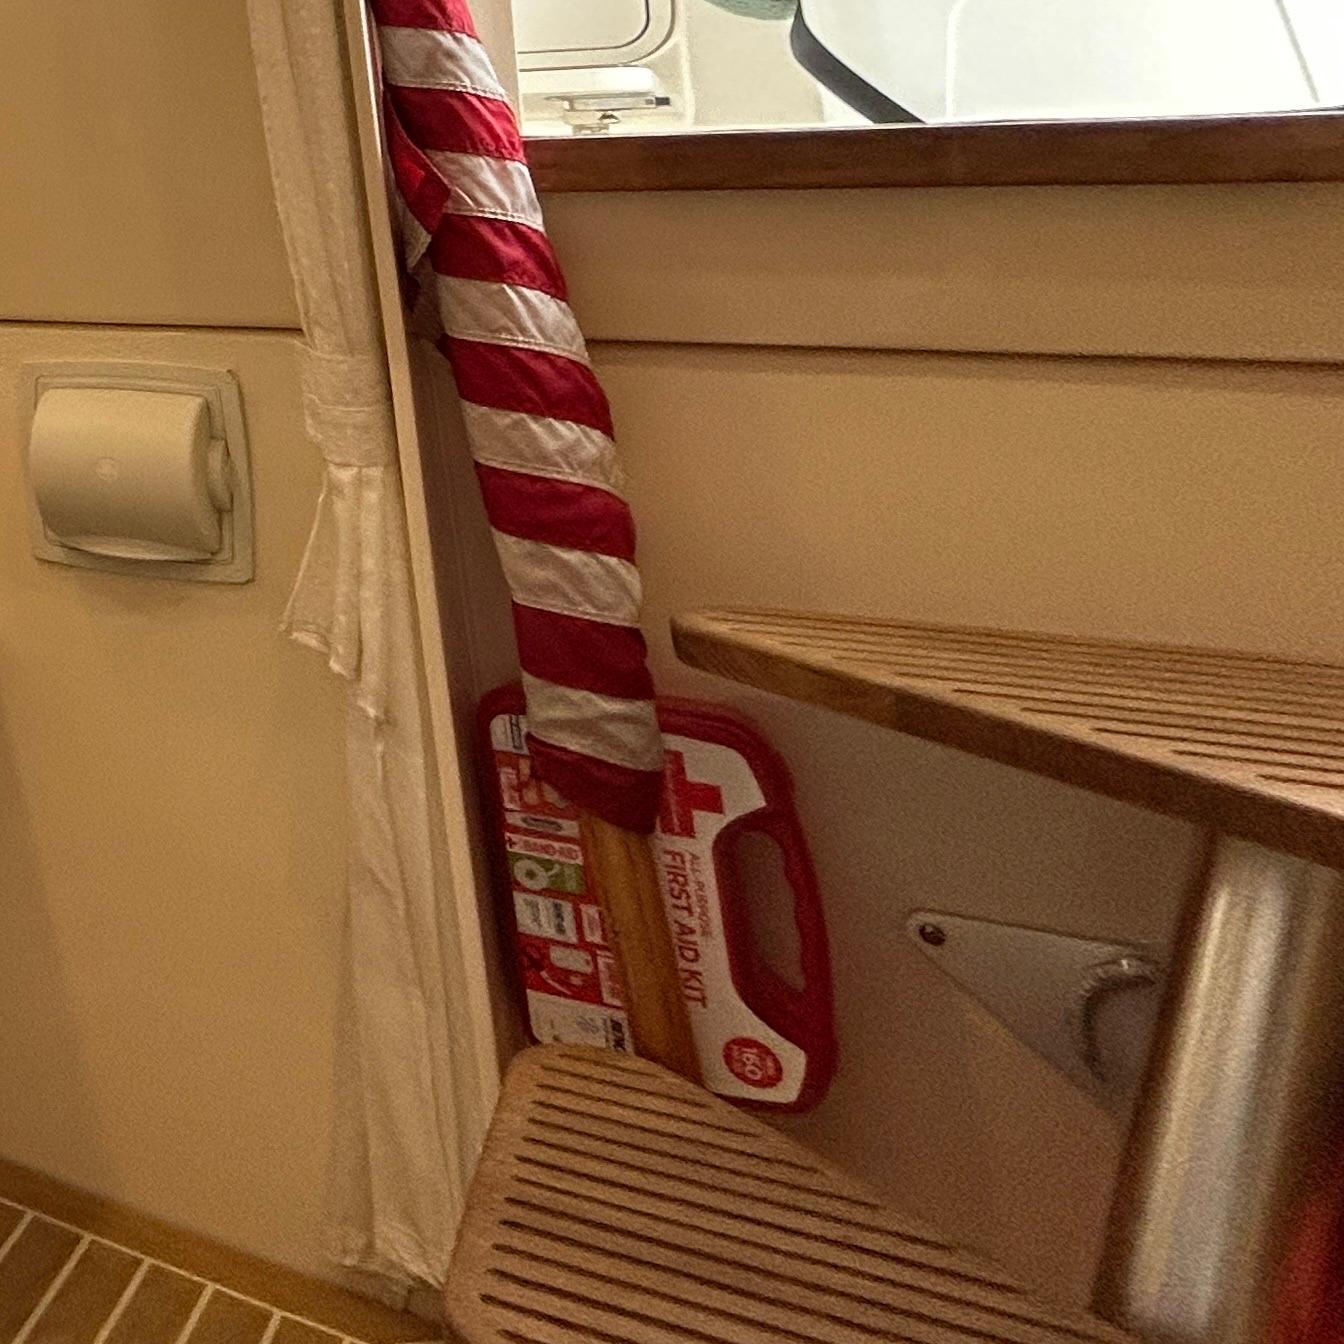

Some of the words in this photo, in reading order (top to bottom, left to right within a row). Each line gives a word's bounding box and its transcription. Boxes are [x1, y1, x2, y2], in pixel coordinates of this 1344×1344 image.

[663, 848, 694, 918] FIRST
[673, 919, 701, 963] AID
[679, 967, 708, 1009] KIT
